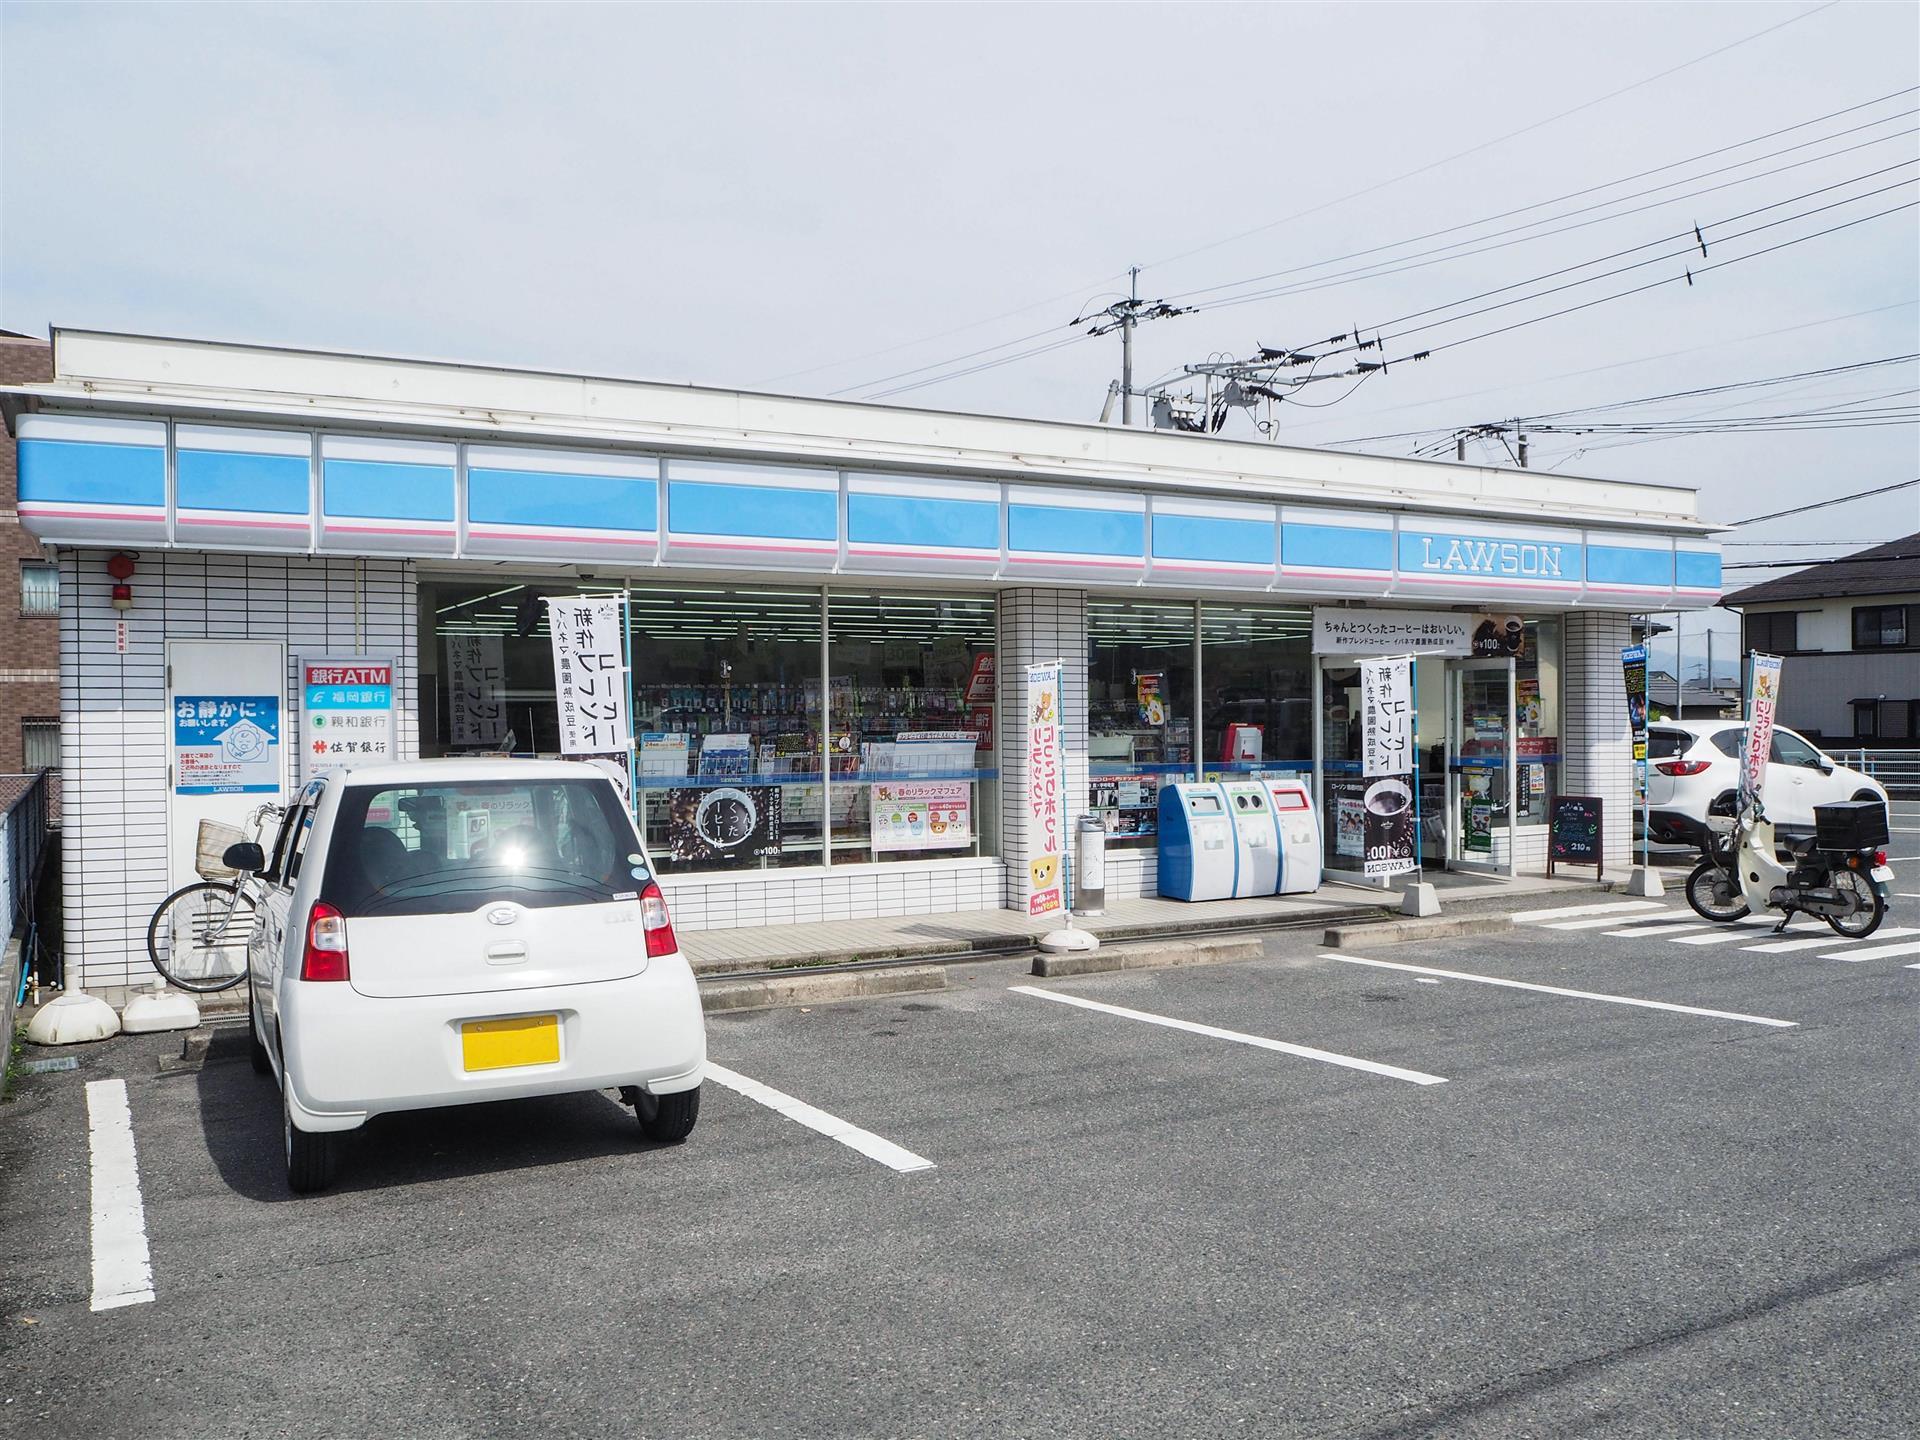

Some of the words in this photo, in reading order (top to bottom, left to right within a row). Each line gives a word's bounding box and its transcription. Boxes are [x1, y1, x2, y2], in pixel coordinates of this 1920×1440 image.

[1422, 537, 1562, 576] LAWSON
[1324, 620, 1466, 636] ちゃんとつくったコーヒーはおいしい。
[1336, 636, 1391, 646] 新作ブレンドコーヒー
[311, 669, 387, 684] 銀行ATM
[332, 690, 386, 703] 福岡銀行
[176, 701, 257, 718] お静かに
[331, 715, 387, 728] 親和銀行
[330, 741, 387, 753] 佐賀銀行
